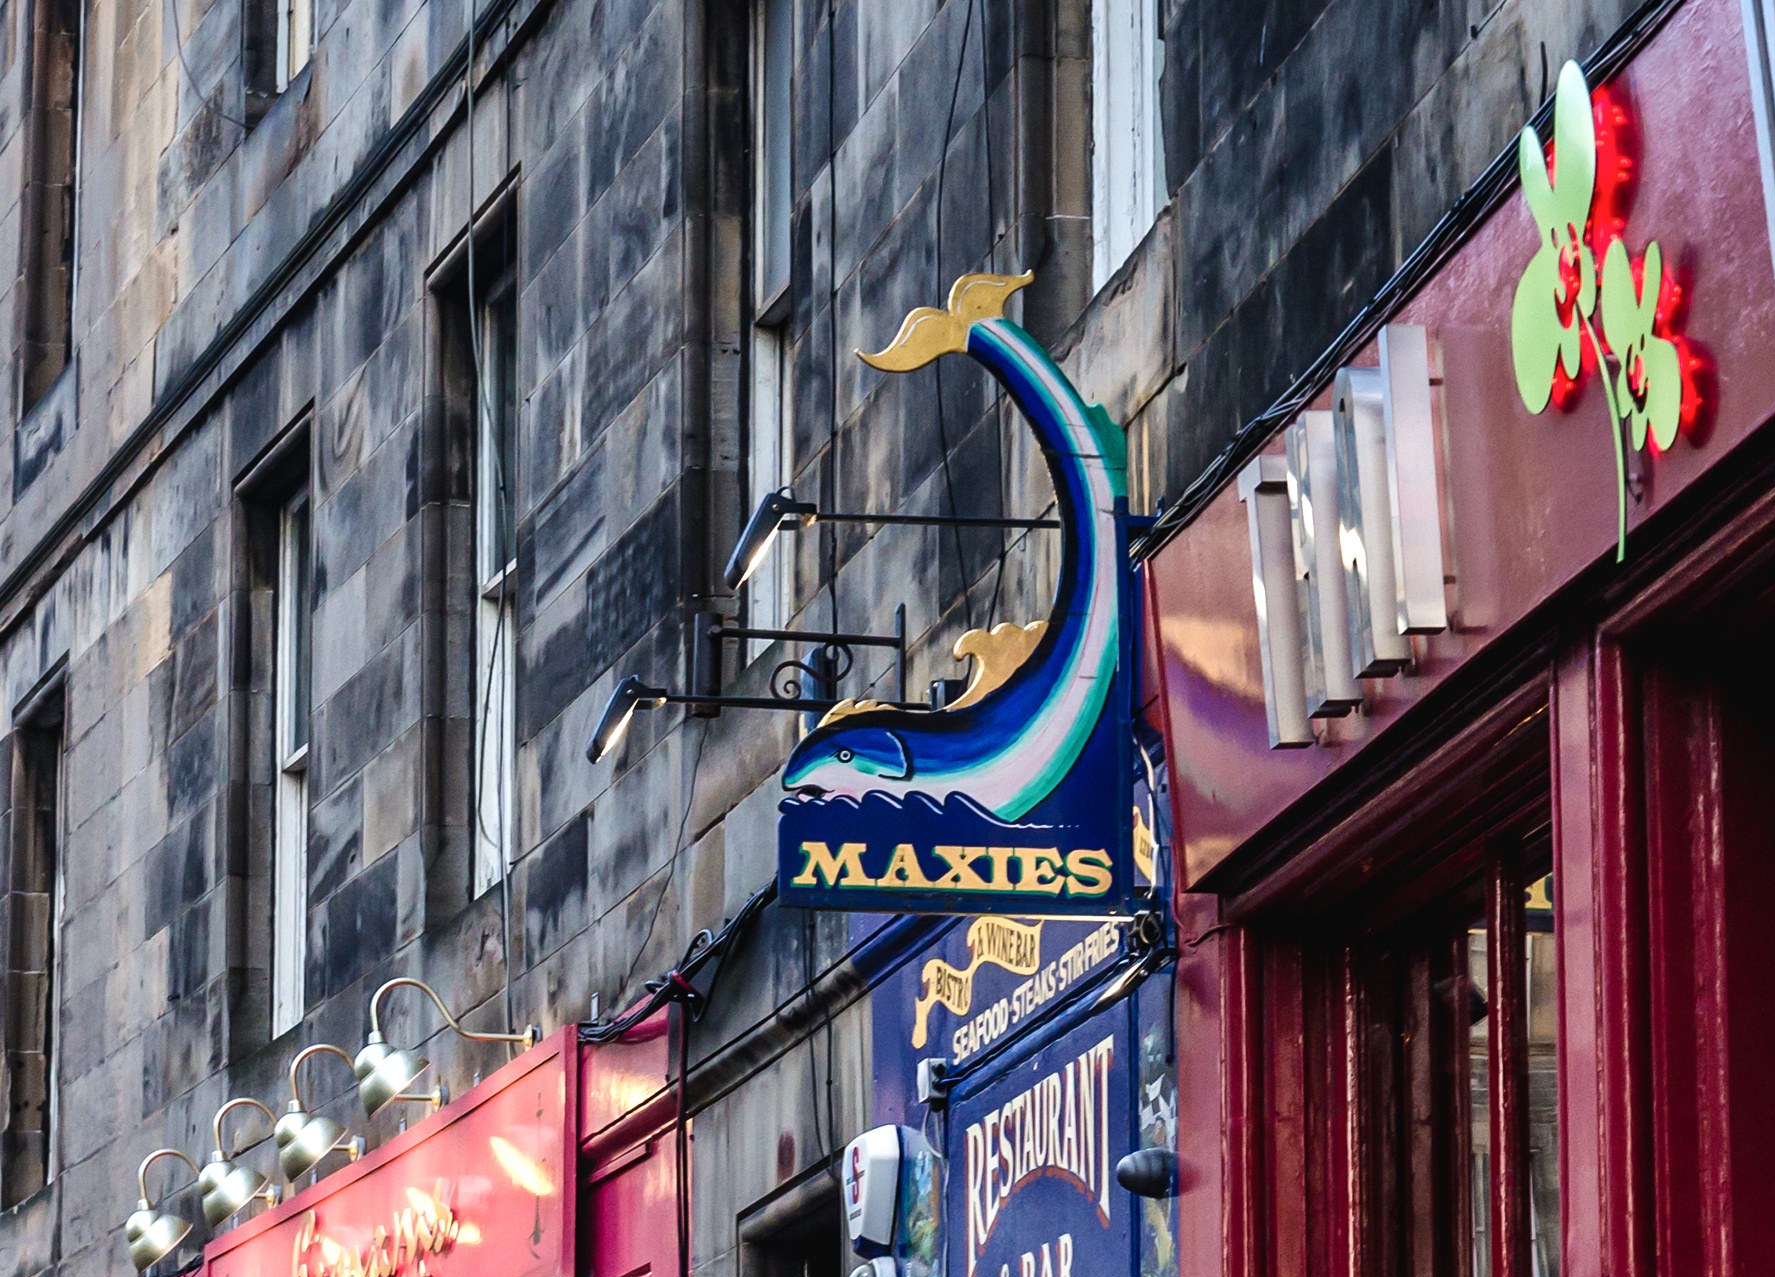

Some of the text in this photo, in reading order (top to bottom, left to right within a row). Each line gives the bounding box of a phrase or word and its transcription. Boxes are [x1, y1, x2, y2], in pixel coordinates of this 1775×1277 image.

[792, 841, 1113, 897] MAXIES
[986, 922, 1014, 964] WINE
[1015, 930, 1036, 968] BAR
[935, 966, 970, 1011] BISTRO
